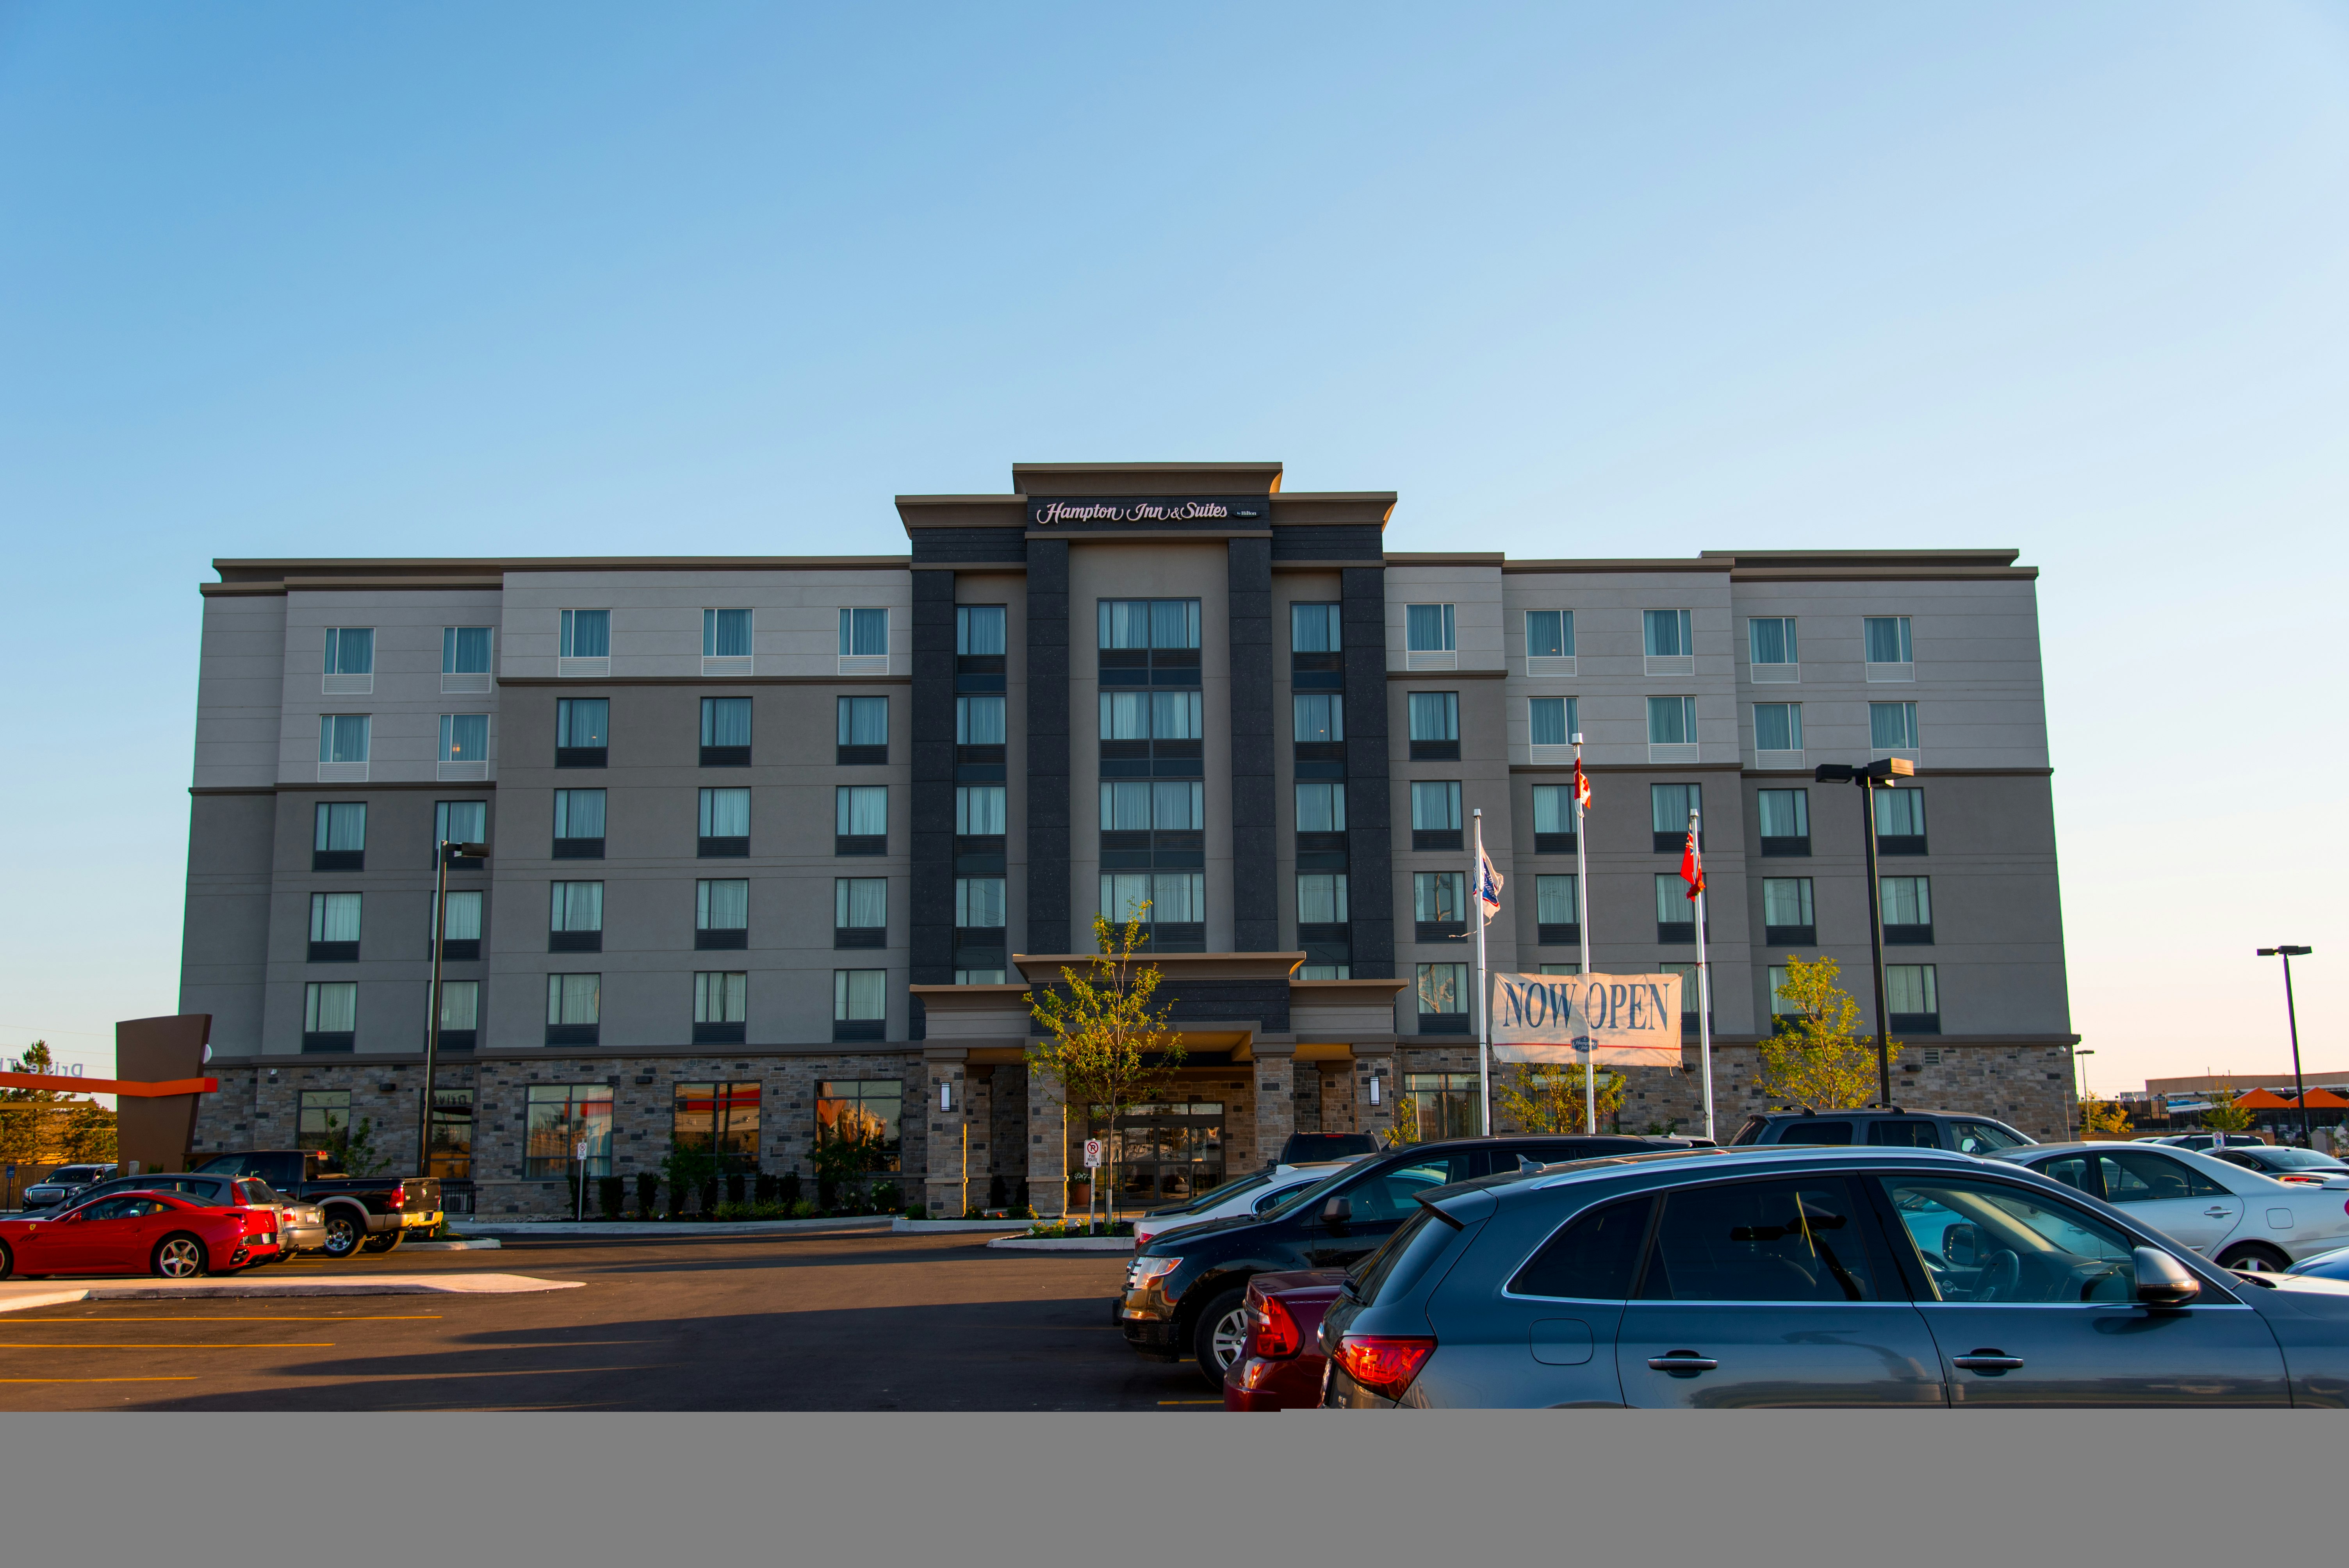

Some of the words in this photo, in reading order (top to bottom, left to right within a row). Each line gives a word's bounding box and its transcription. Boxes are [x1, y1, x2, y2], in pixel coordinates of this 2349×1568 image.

[1037, 502, 1124, 524] Hampton
[1126, 503, 1170, 521] Inn
[1180, 502, 1227, 519] Suites
[1503, 982, 1577, 1028] NOW
[1584, 982, 1670, 1031] OPEN
